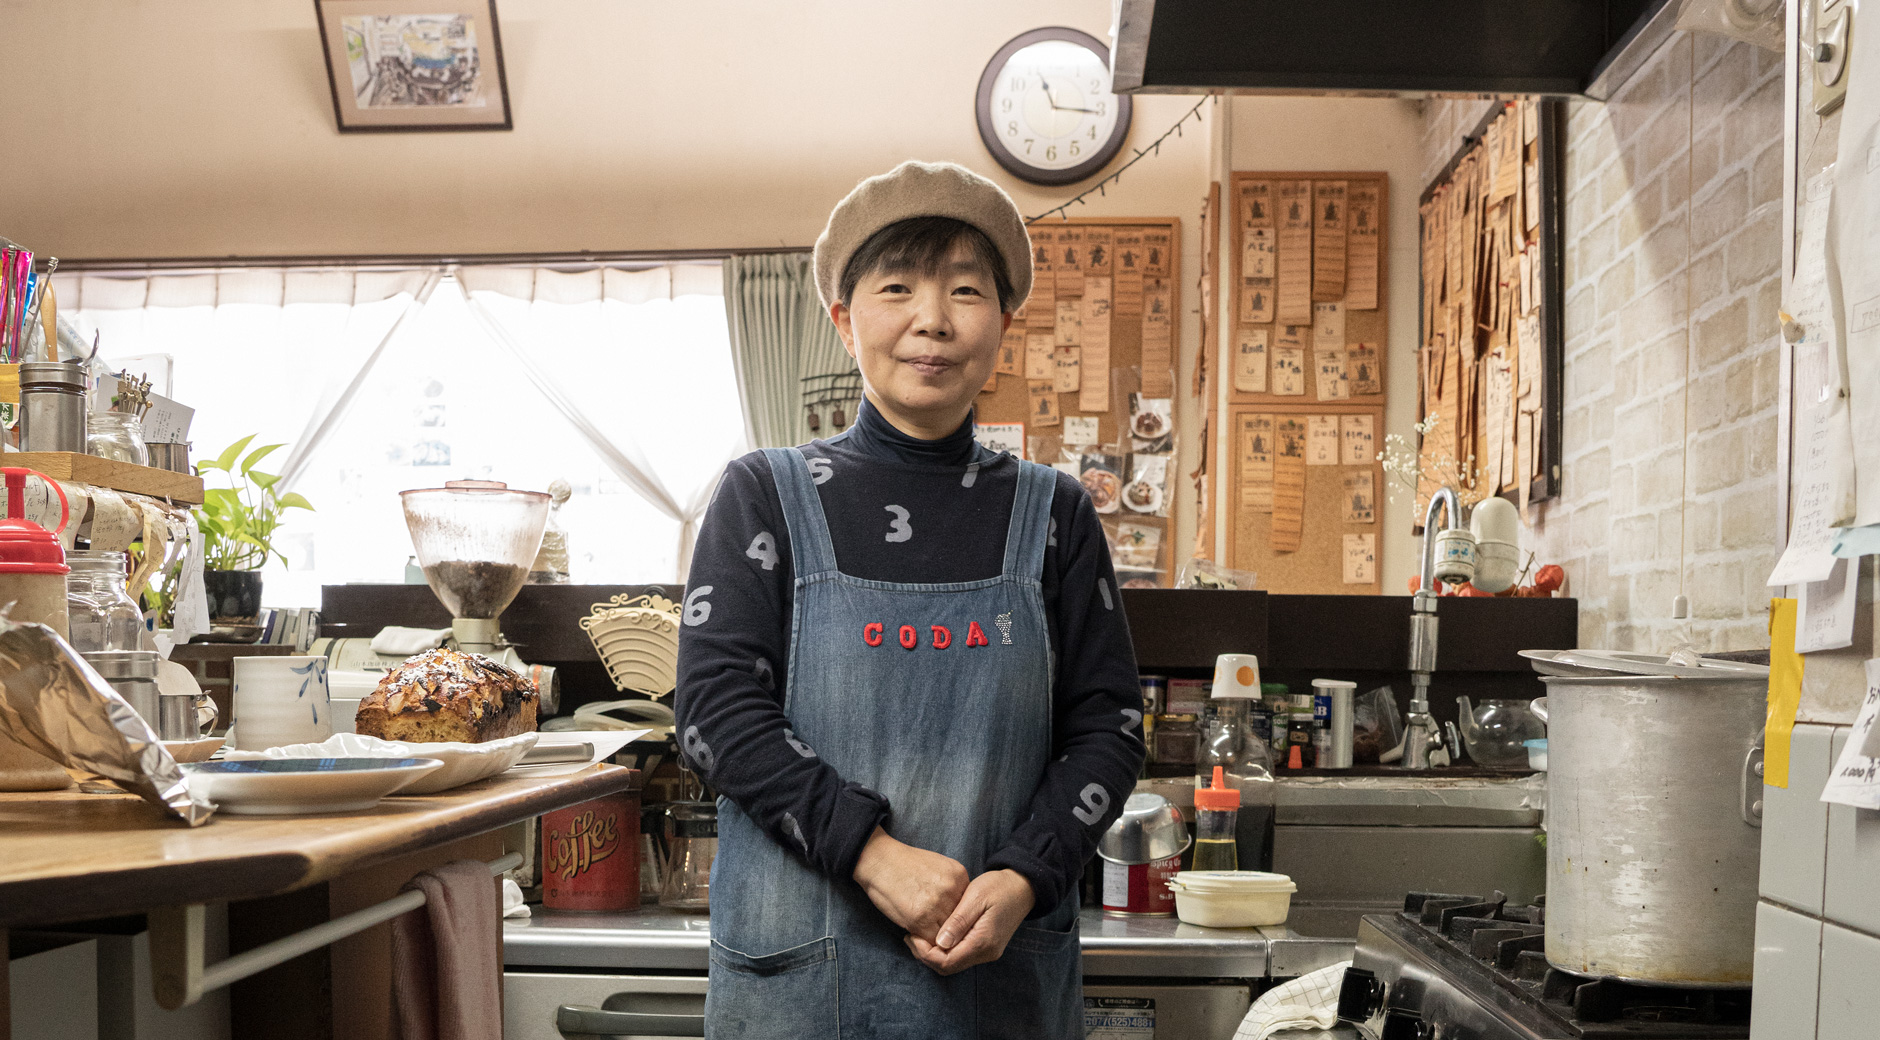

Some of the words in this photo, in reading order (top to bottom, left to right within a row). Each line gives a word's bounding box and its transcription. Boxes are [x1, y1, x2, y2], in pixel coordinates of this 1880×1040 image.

[1007, 122, 1018, 136] 8
[1086, 124, 1097, 140] 4
[1024, 139, 1035, 154] 7
[1046, 146, 1057, 161] 6
[1069, 141, 1081, 156] 5
[884, 504, 913, 543] 3
[746, 531, 780, 571] 4
[683, 585, 714, 627] 6
[864, 621, 988, 650] CODA
[683, 725, 714, 771] 8
[547, 810, 620, 882] Coffee
